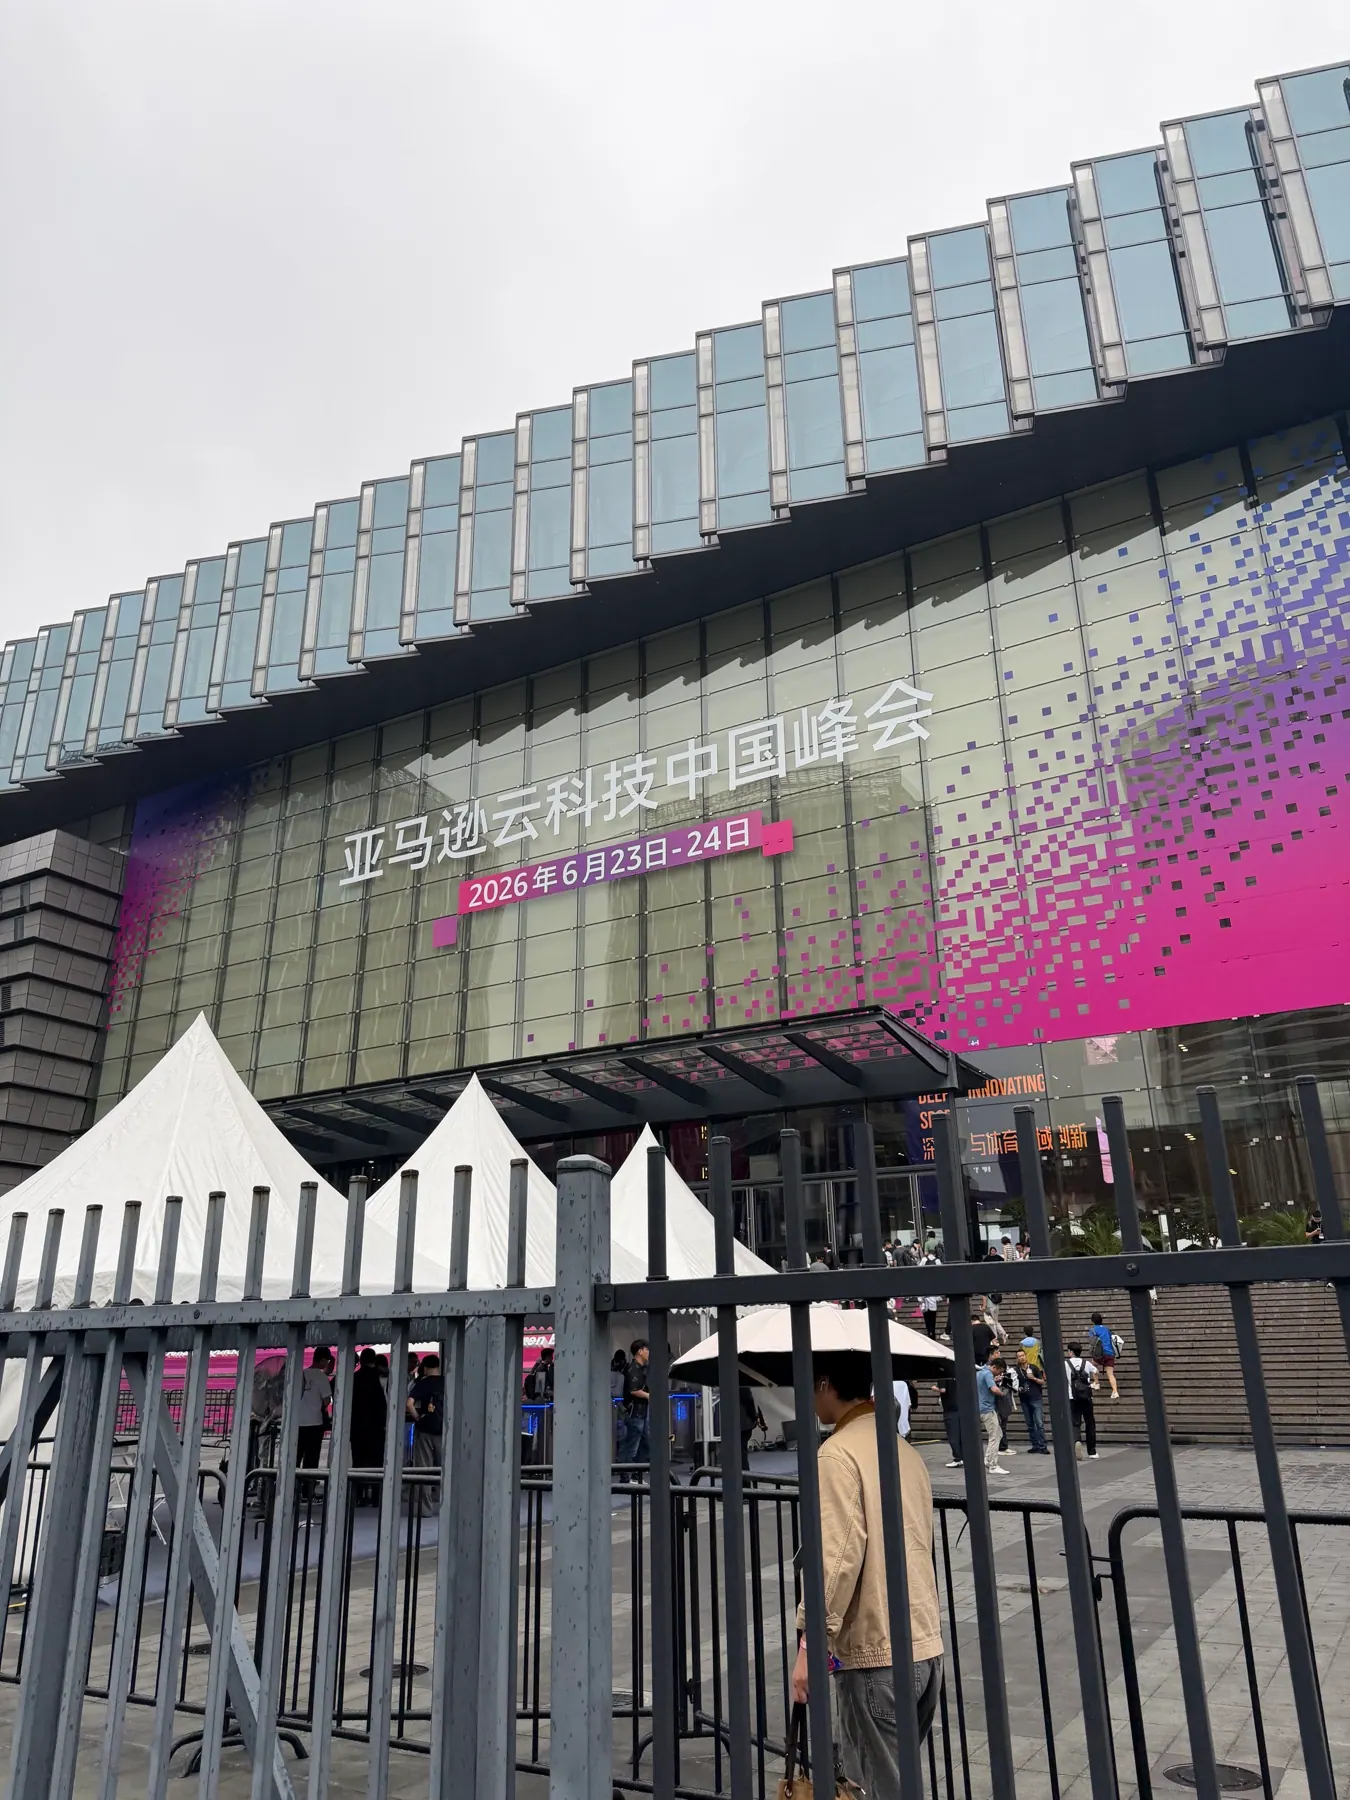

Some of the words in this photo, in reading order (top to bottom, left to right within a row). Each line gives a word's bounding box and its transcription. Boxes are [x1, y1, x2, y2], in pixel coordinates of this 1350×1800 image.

[339, 679, 934, 886] 亚马逊云科技中国峰会
